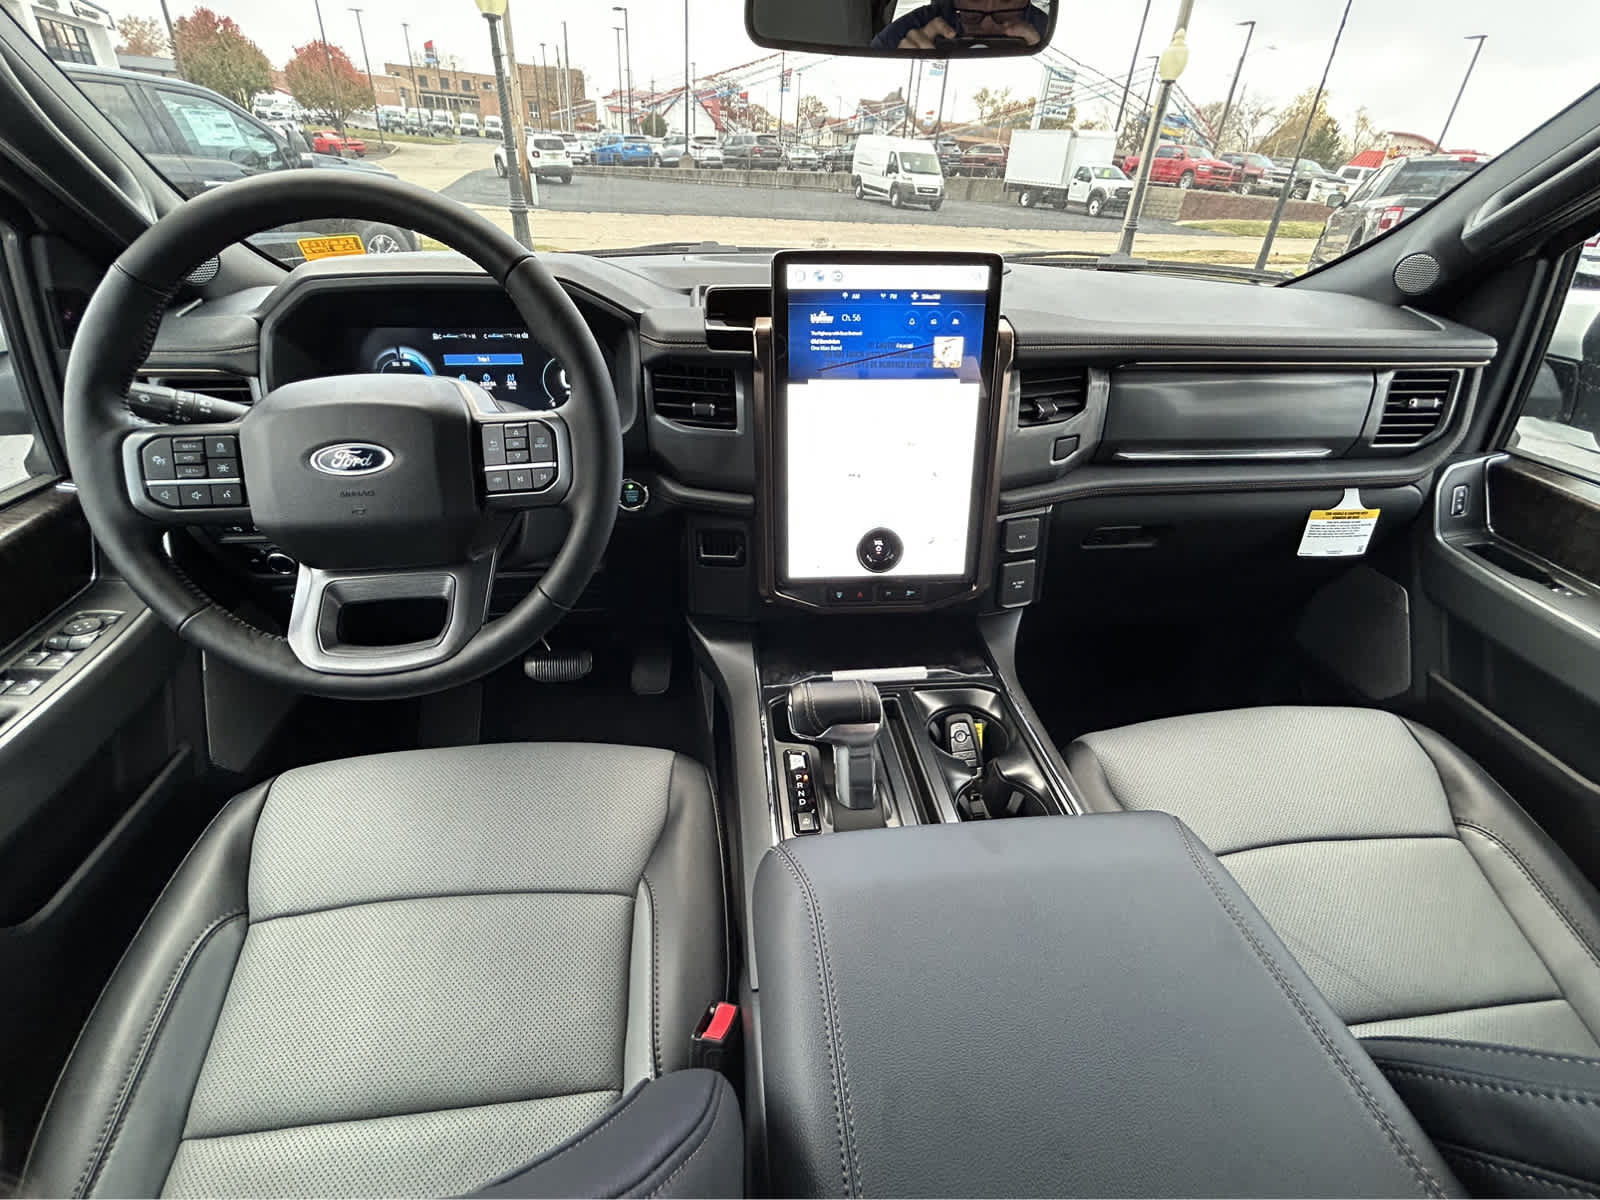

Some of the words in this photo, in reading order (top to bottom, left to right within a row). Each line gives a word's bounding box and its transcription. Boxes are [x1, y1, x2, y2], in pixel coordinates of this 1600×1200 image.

[842, 314, 851, 322] Ch.
[852, 314, 861, 322] 56
[331, 449, 373, 468] Ford
[799, 798, 807, 806] D
